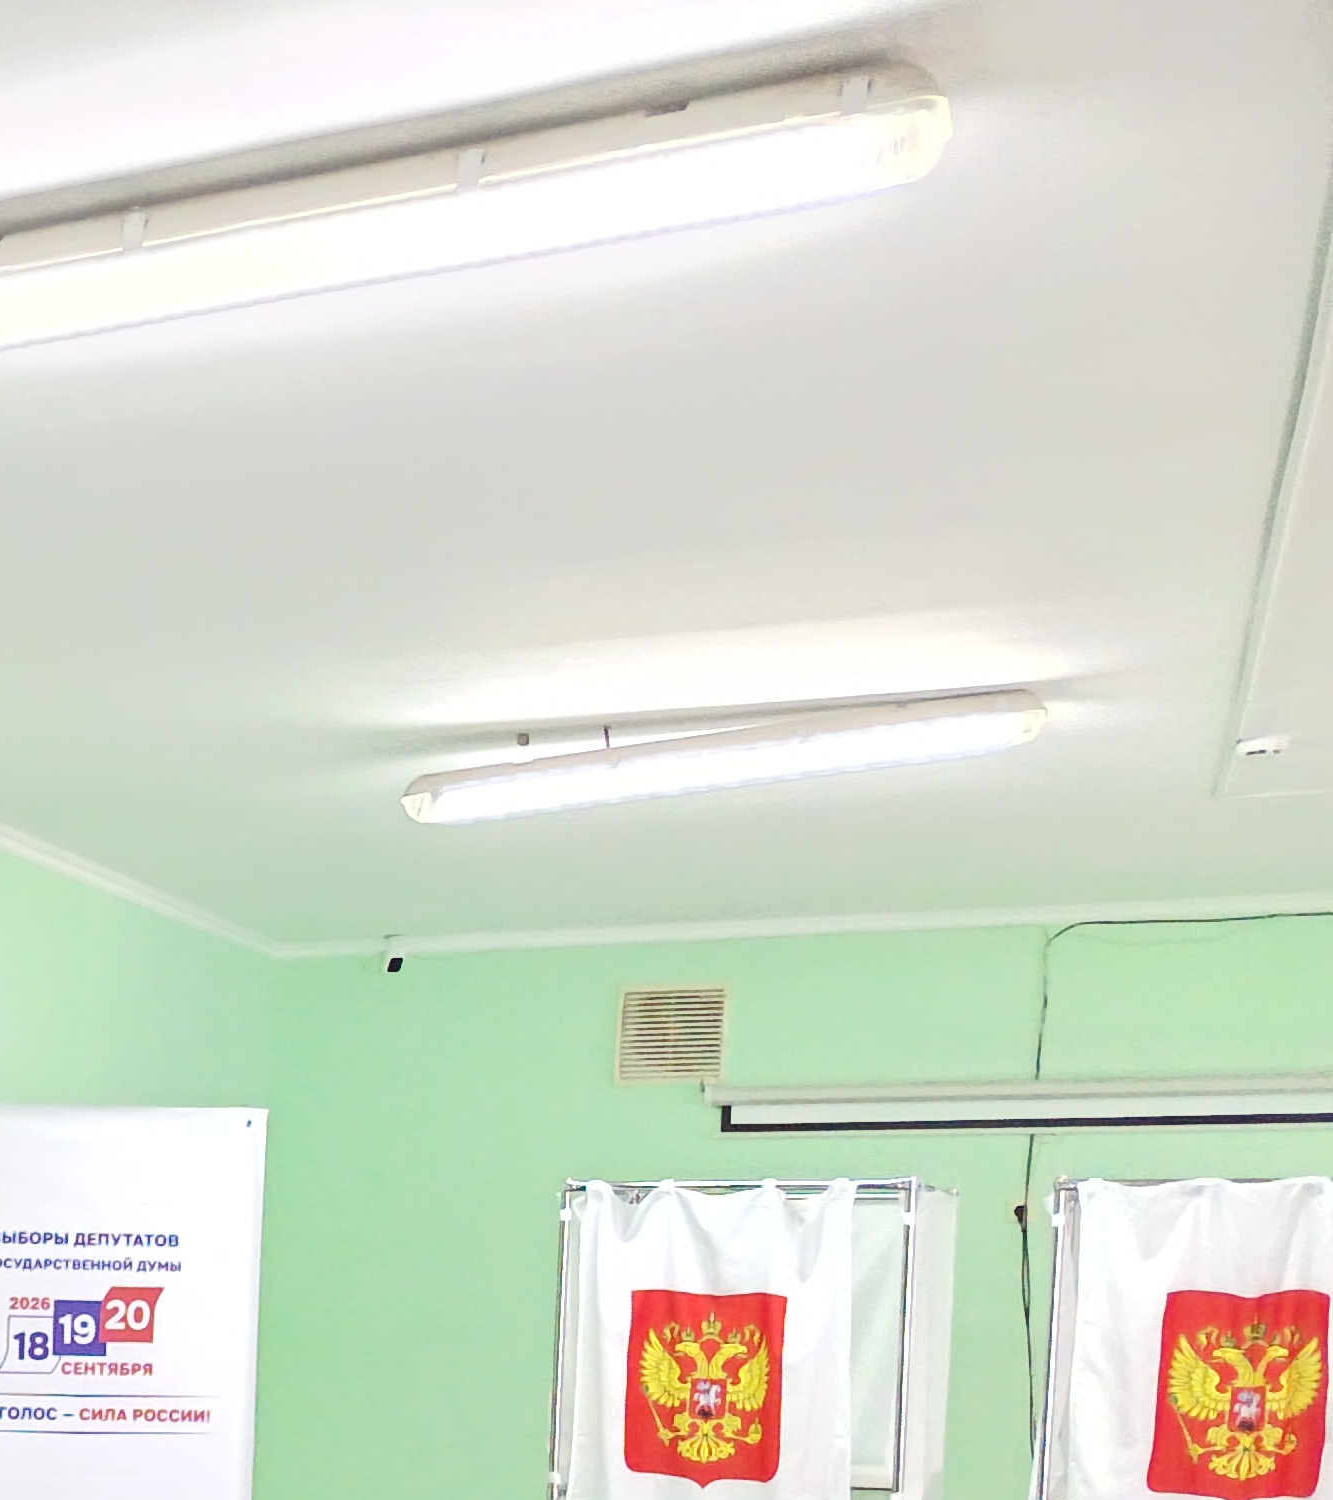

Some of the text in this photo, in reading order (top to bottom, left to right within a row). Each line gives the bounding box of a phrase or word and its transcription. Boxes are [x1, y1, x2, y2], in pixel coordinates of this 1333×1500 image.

[73, 1232, 180, 1249] ДЕПУТАТОВ
[136, 1260, 182, 1273] ДУМЫ
[9, 1296, 51, 1311] 2026
[104, 1299, 151, 1331] 20
[58, 1313, 97, 1345] 19
[13, 1331, 50, 1361] 18
[60, 1361, 154, 1377] СЕНТЯБРЯ
[78, 1407, 129, 1423] СИЛА
[132, 1408, 212, 1424] РОССИИ!
